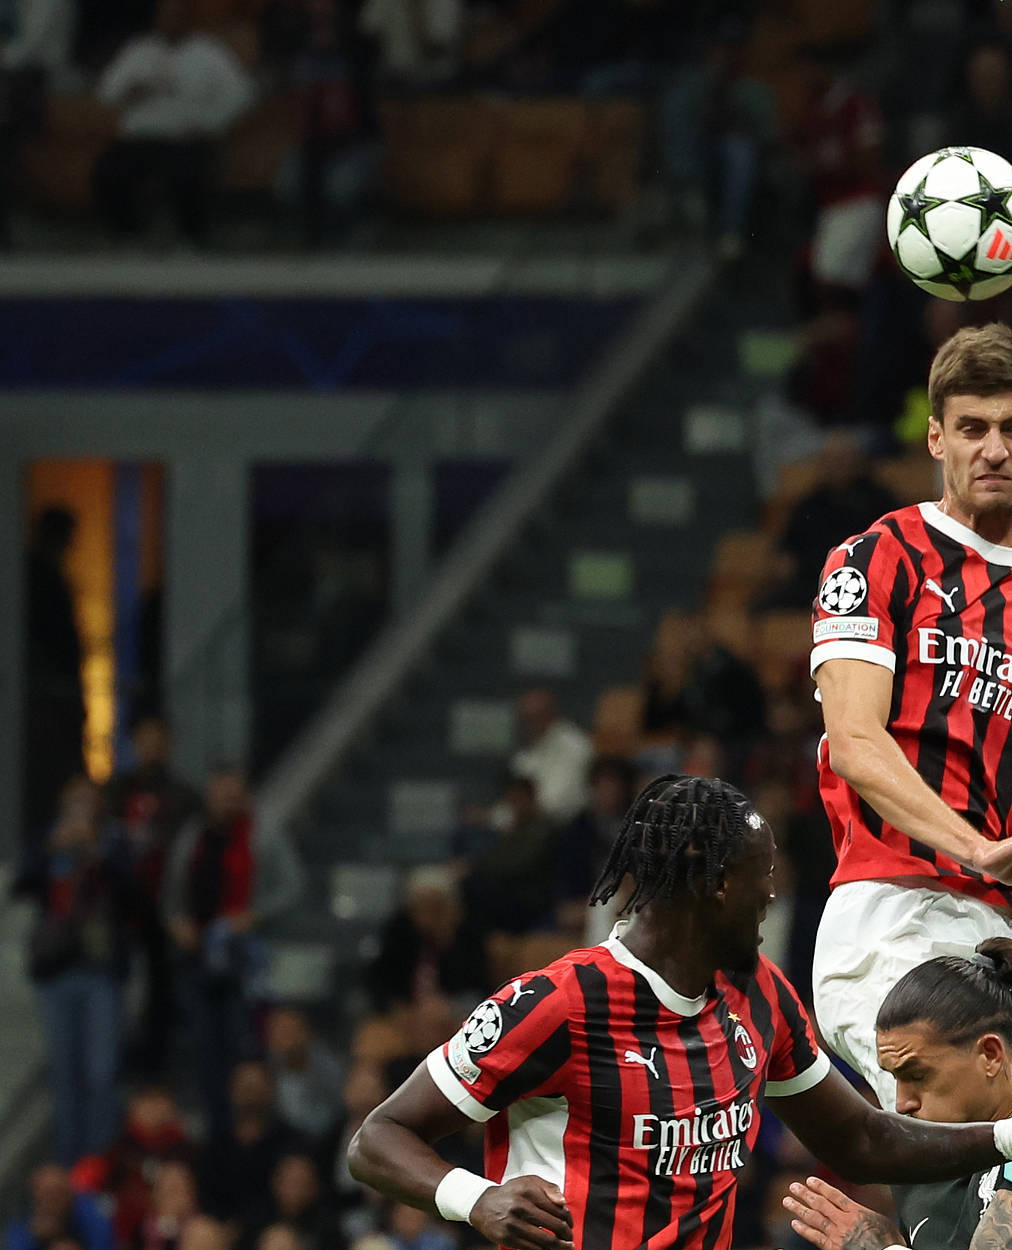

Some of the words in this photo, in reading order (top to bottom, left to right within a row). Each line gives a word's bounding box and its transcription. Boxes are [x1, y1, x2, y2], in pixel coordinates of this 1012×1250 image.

[940, 670, 969, 698] FL
[632, 1099, 754, 1150] Emirates
[655, 1146, 691, 1176] FLY
[690, 1139, 744, 1175] BETTER
